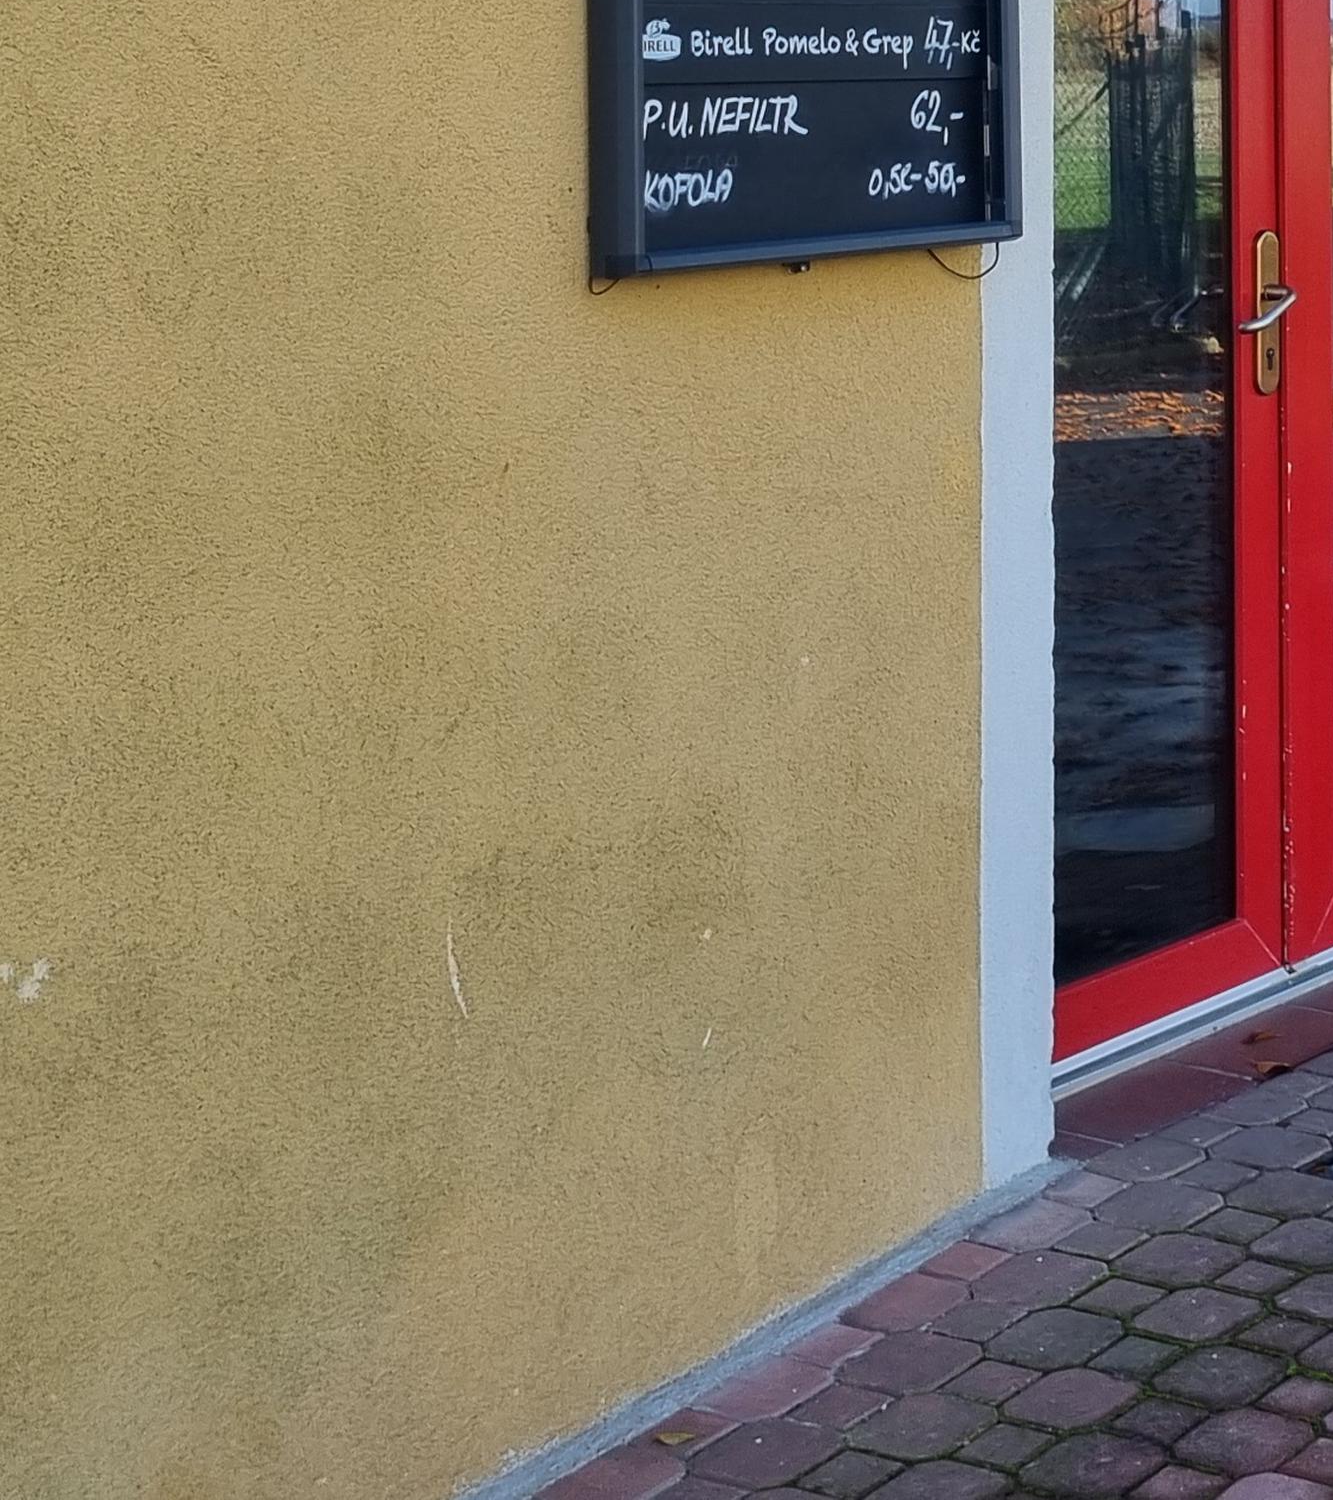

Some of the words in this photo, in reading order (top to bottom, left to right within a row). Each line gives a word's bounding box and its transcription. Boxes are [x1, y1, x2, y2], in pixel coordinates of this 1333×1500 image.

[691, 29, 753, 57] Birell
[763, 27, 841, 56] Pomelo
[862, 27, 914, 70] Grep
[700, 95, 808, 135] NEFILTR
[911, 89, 964, 146] 62,-
[644, 168, 734, 212] KOFOLA
